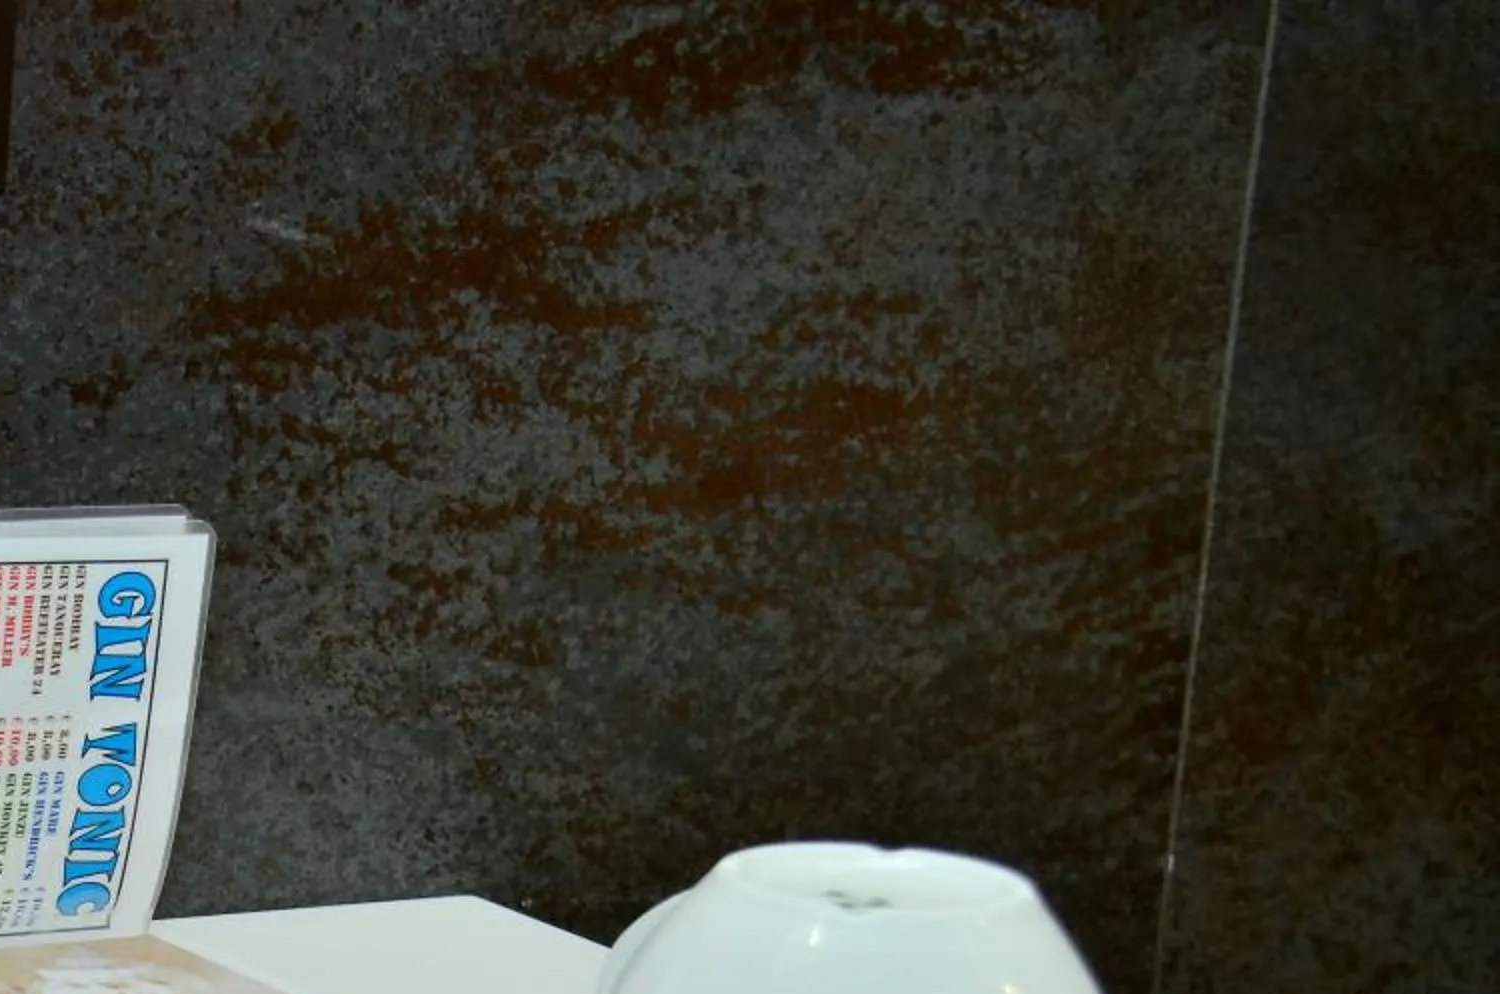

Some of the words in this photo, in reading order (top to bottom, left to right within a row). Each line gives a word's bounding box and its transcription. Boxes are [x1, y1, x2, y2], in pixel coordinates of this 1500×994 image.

[8, 566, 20, 590] GIN
[25, 566, 36, 590] GIN
[42, 566, 53, 589] GIN
[58, 566, 70, 589] GIN
[75, 566, 87, 589] GIN
[20, 595, 35, 656] BOBBY'S
[70, 594, 84, 650] BOMBAY
[1, 616, 16, 667] MILLER
[34, 595, 50, 675] BEEFEATER
[50, 595, 68, 676] TANQUERAY
[89, 572, 157, 701] GIN
[31, 680, 42, 695] 24
[5, 773, 17, 797] GIN
[20, 773, 33, 796] GIN
[38, 772, 49, 795] GIN
[54, 772, 65, 794] GIN
[48, 799, 62, 834] MARE
[56, 723, 137, 916] TONIC
